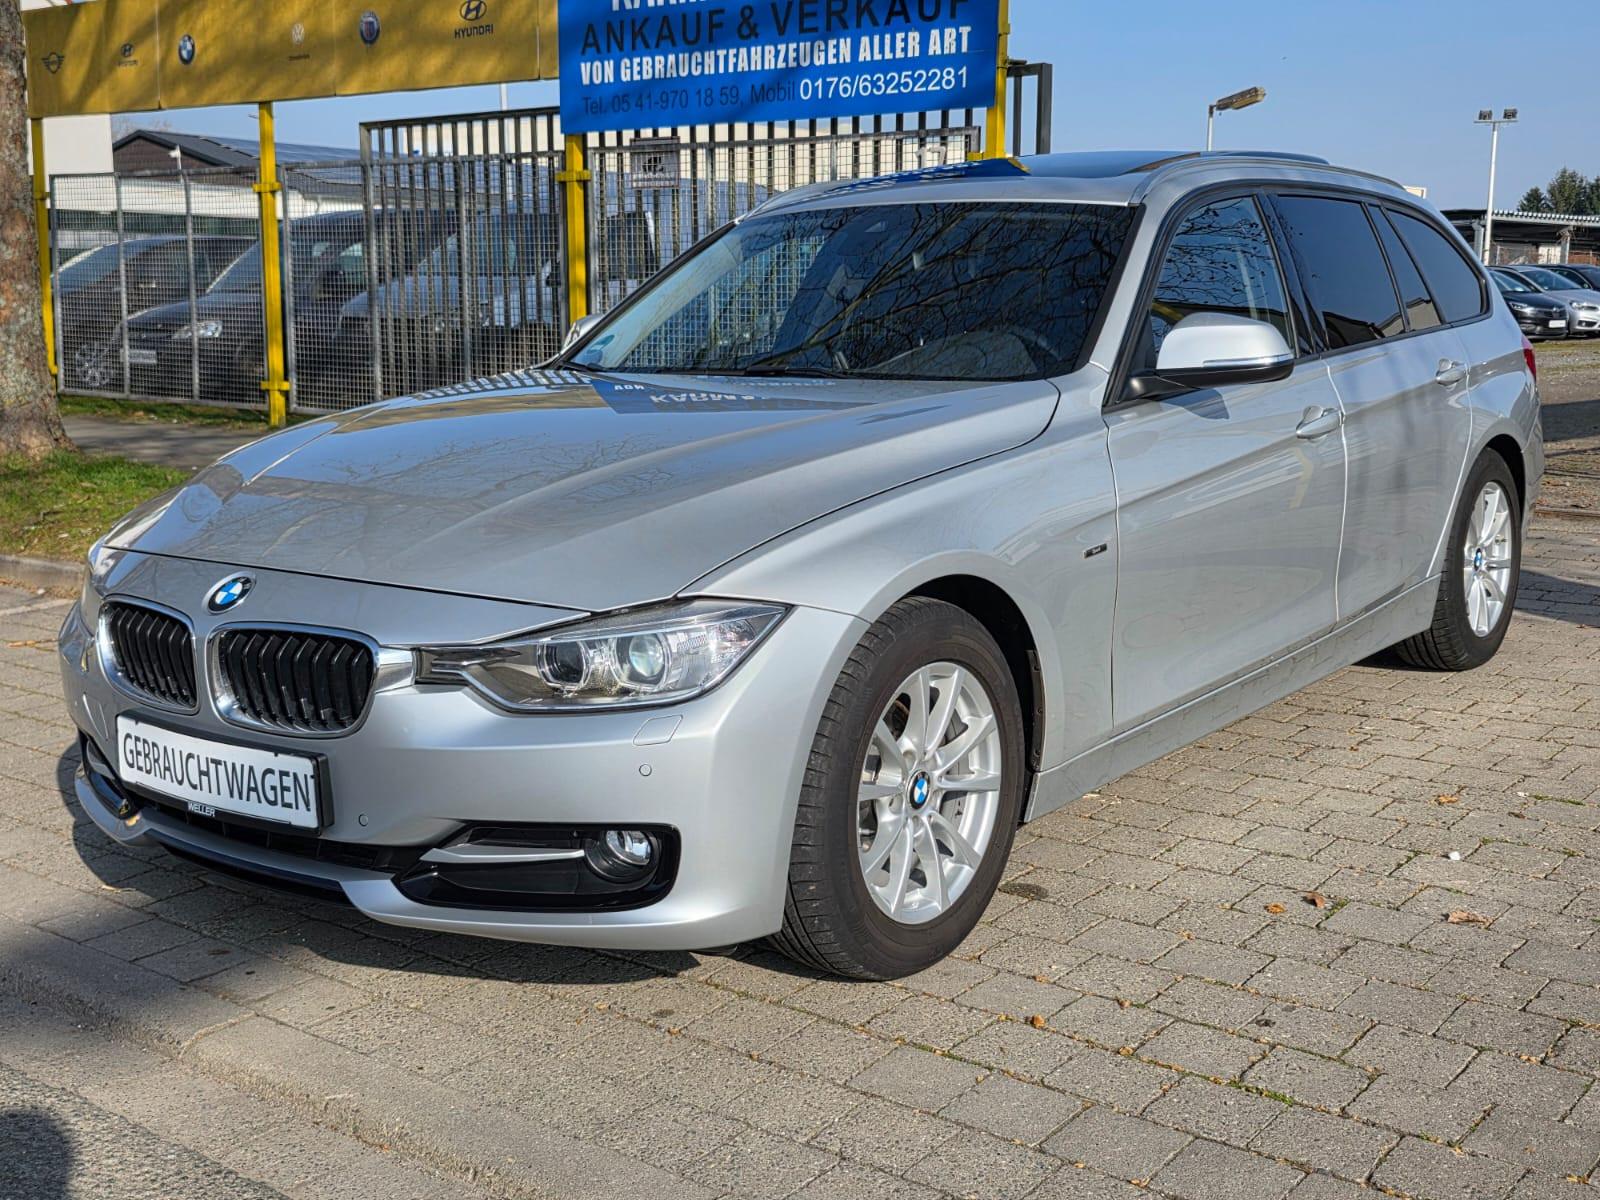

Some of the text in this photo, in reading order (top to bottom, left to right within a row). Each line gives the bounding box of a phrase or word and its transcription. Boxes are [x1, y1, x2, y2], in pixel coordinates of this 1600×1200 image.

[580, 8, 726, 55] ANKAUF
[736, 5, 759, 40] &
[580, 25, 972, 85] VON GEBRAUCHTFAHRZEUGEN ALLER ART
[583, 97, 607, 115] Tel.
[611, 94, 632, 113] 05
[695, 88, 714, 108] 18
[751, 80, 796, 104] Mobil
[800, 66, 968, 100] 0176/63252281
[123, 732, 311, 812] GEBRAUCHTWAGEN
[187, 801, 216, 818] WELLER
